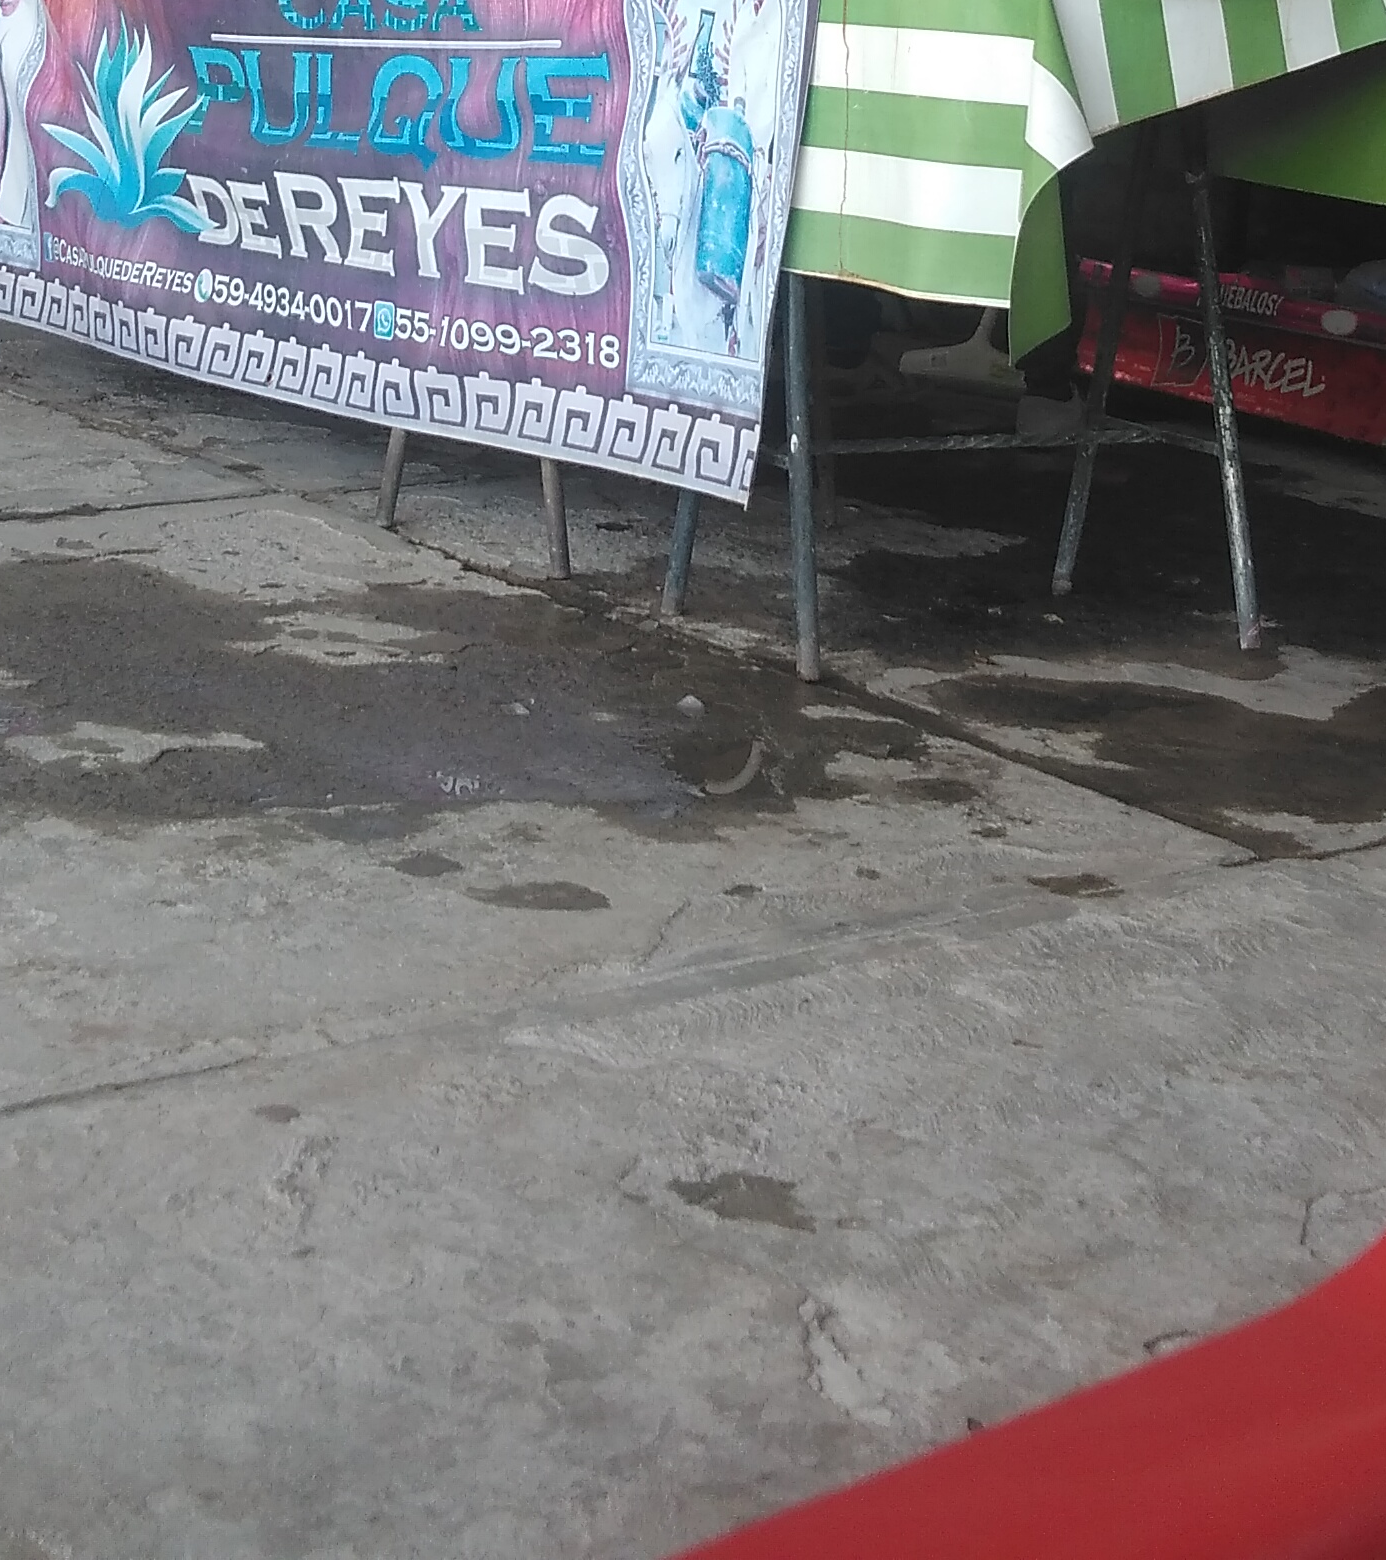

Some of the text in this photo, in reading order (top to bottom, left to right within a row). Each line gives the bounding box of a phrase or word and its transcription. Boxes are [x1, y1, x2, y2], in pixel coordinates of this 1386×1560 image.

[186, 46, 611, 173] PULQUE
[213, 273, 621, 370] 59-4934-0017 55-1099-2318
